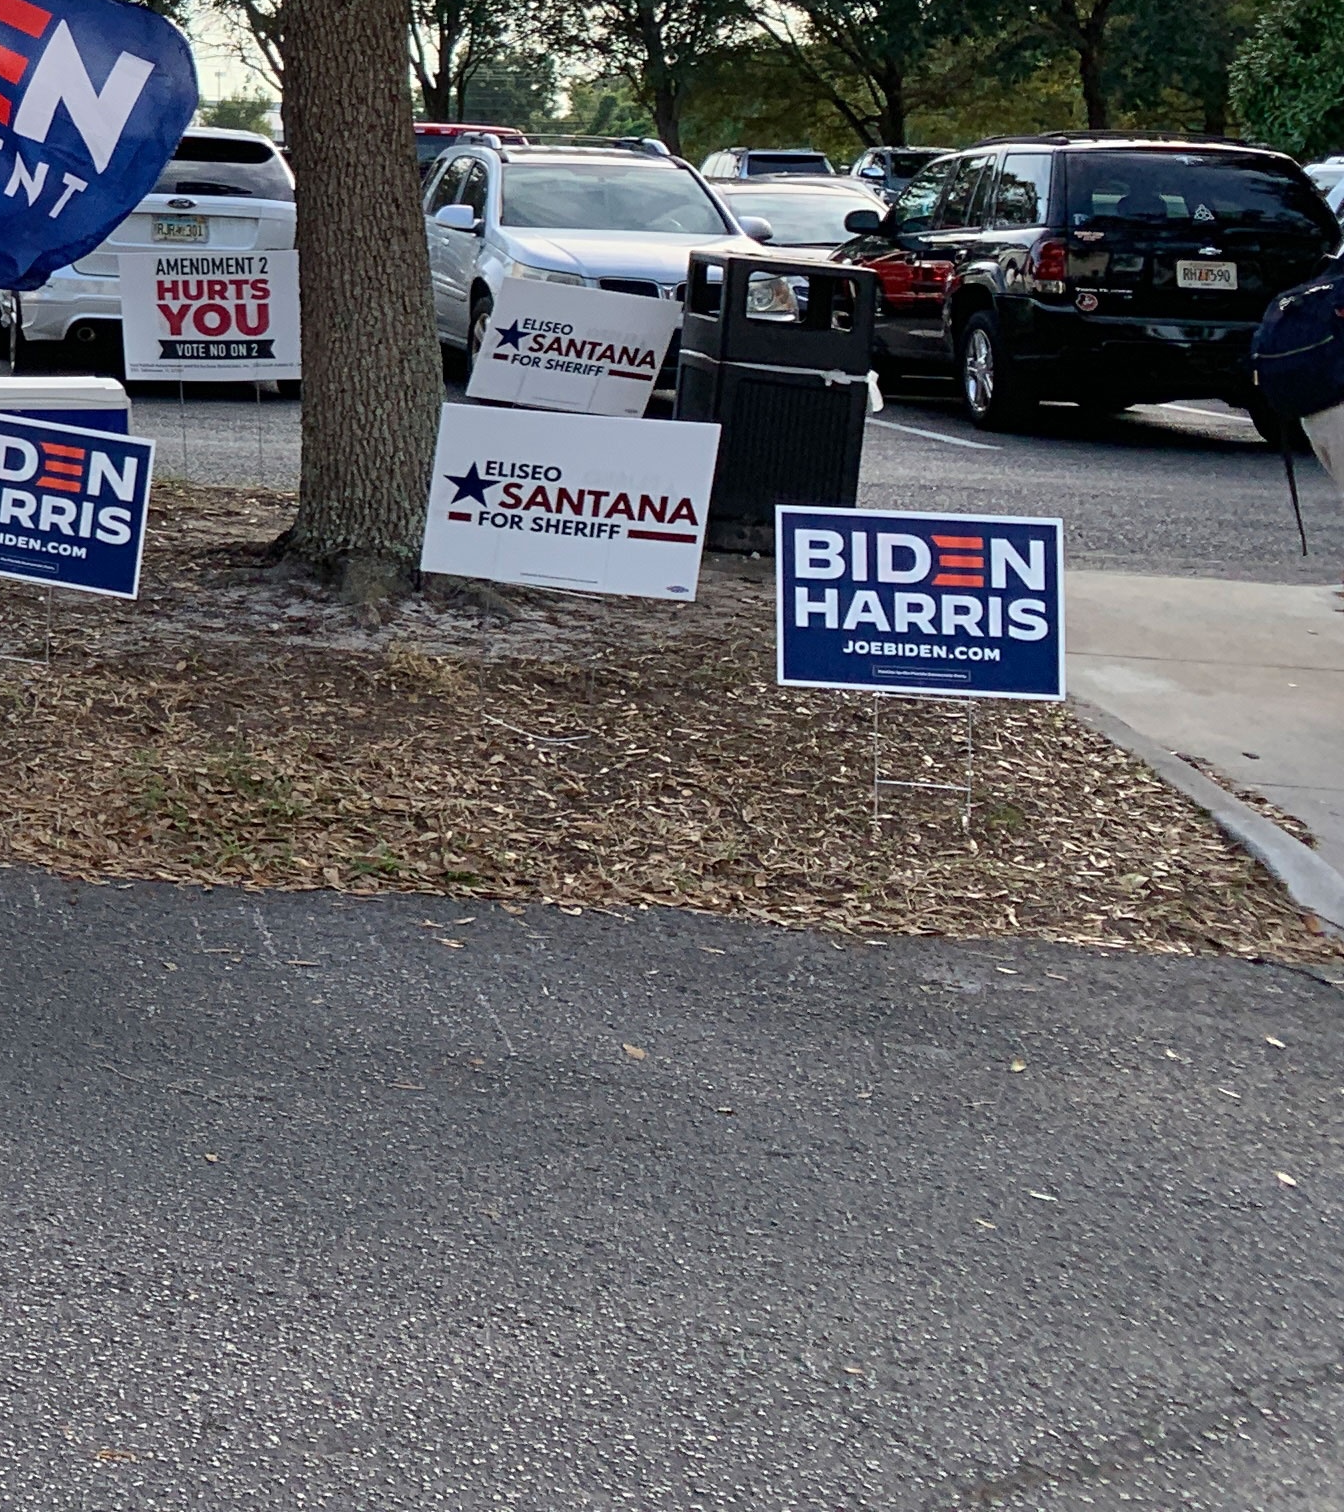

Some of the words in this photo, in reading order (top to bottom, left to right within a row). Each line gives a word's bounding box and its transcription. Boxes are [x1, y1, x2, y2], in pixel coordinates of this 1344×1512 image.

[156, 258, 254, 276] AMENDMENT
[258, 257, 269, 275] 2
[156, 278, 271, 301] HURTS
[156, 303, 270, 337] YOU
[522, 318, 574, 336] ELISEO
[176, 343, 206, 357] VOTE
[210, 343, 226, 357] NO
[230, 343, 248, 357] ON
[251, 343, 259, 357] 2
[528, 333, 657, 370] SANTANA
[511, 353, 541, 369] FOR
[544, 358, 606, 377] SHERIFF
[485, 460, 562, 482] ELISEO
[498, 482, 699, 526] SANTANA
[478, 511, 523, 531] FOR
[530, 516, 621, 539] SHERIFF
[794, 528, 1046, 591] BIDEN
[795, 586, 1049, 642] HARRIS
[843, 640, 1001, 661] JOEBIDEN.COM
